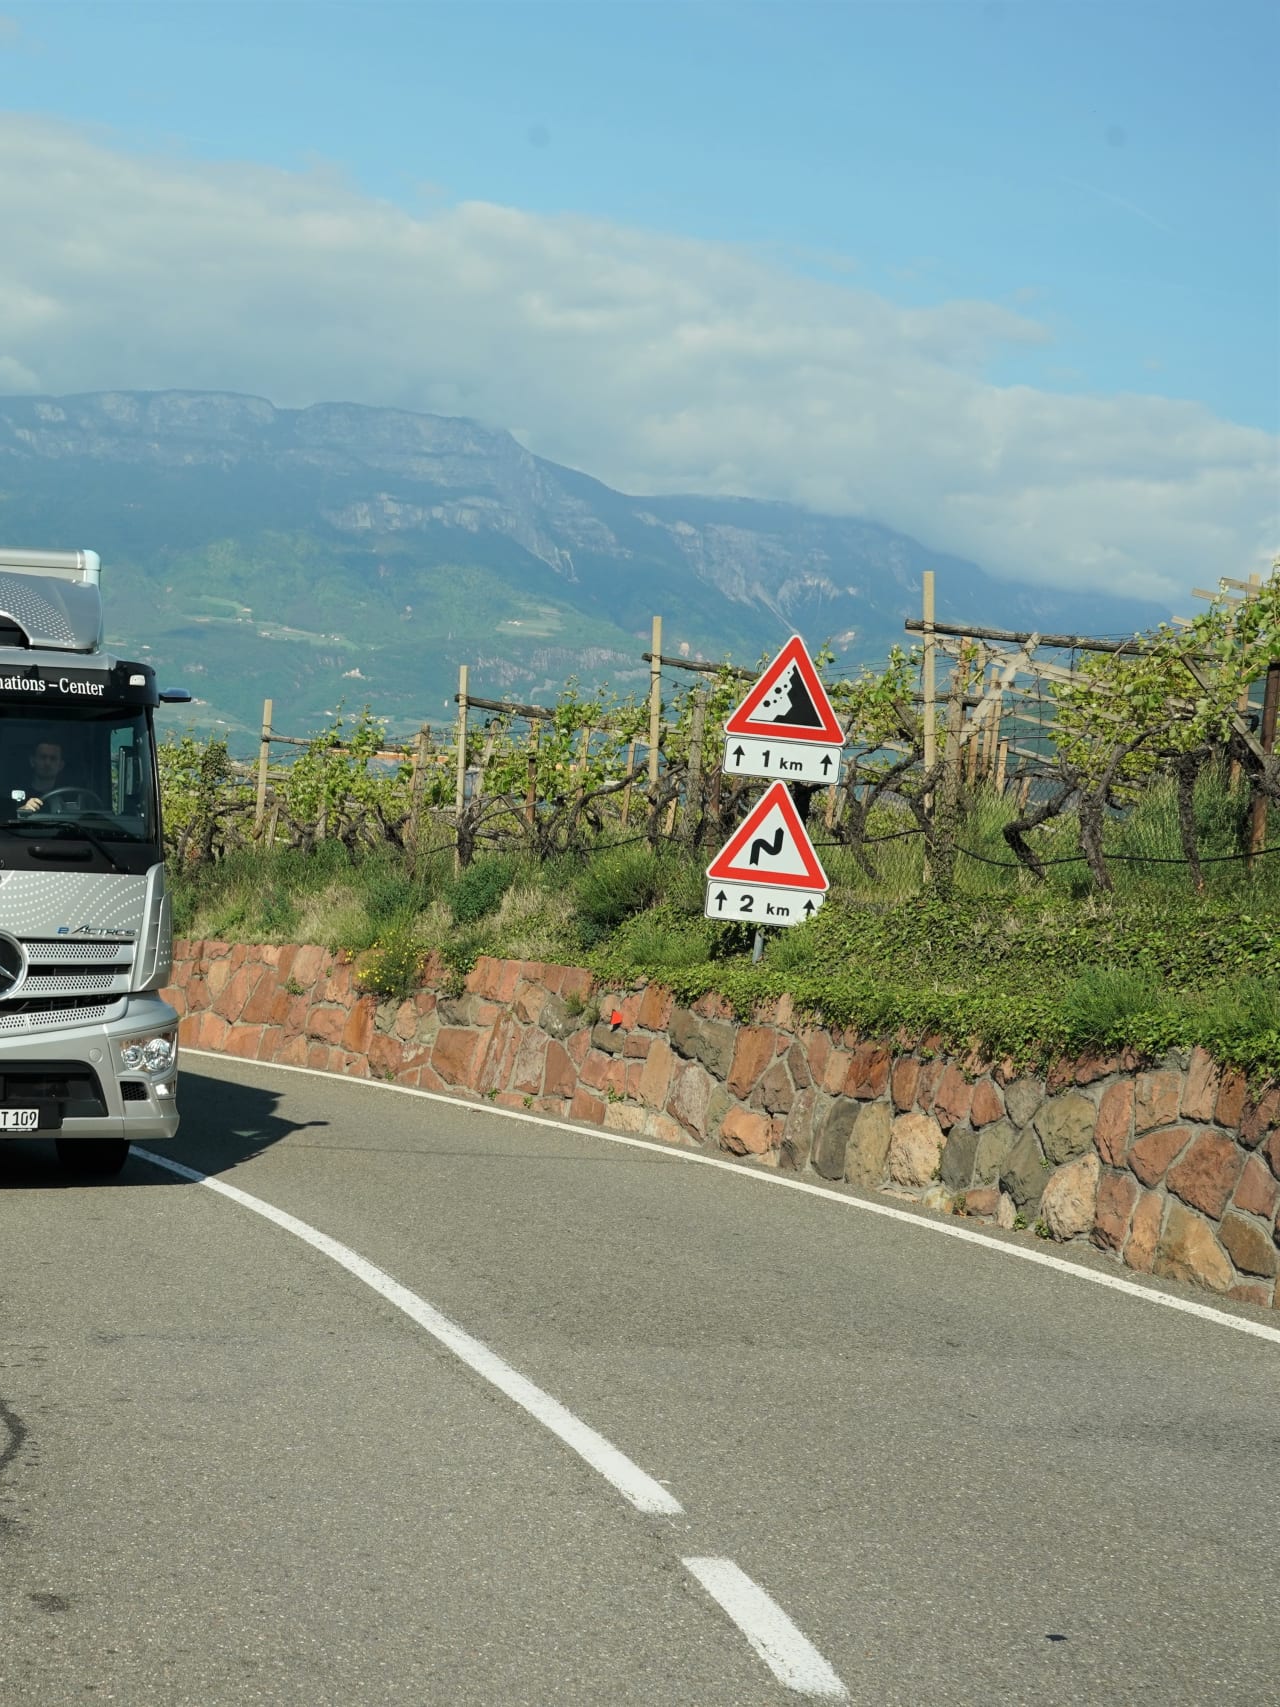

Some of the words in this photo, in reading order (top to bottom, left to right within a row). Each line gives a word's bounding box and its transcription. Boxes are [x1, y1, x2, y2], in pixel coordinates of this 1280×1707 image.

[762, 750, 770, 768] 1
[779, 757, 803, 772] km
[739, 894, 754, 913] 2
[766, 903, 790, 917] km
[12, 1111, 37, 1126] 109
